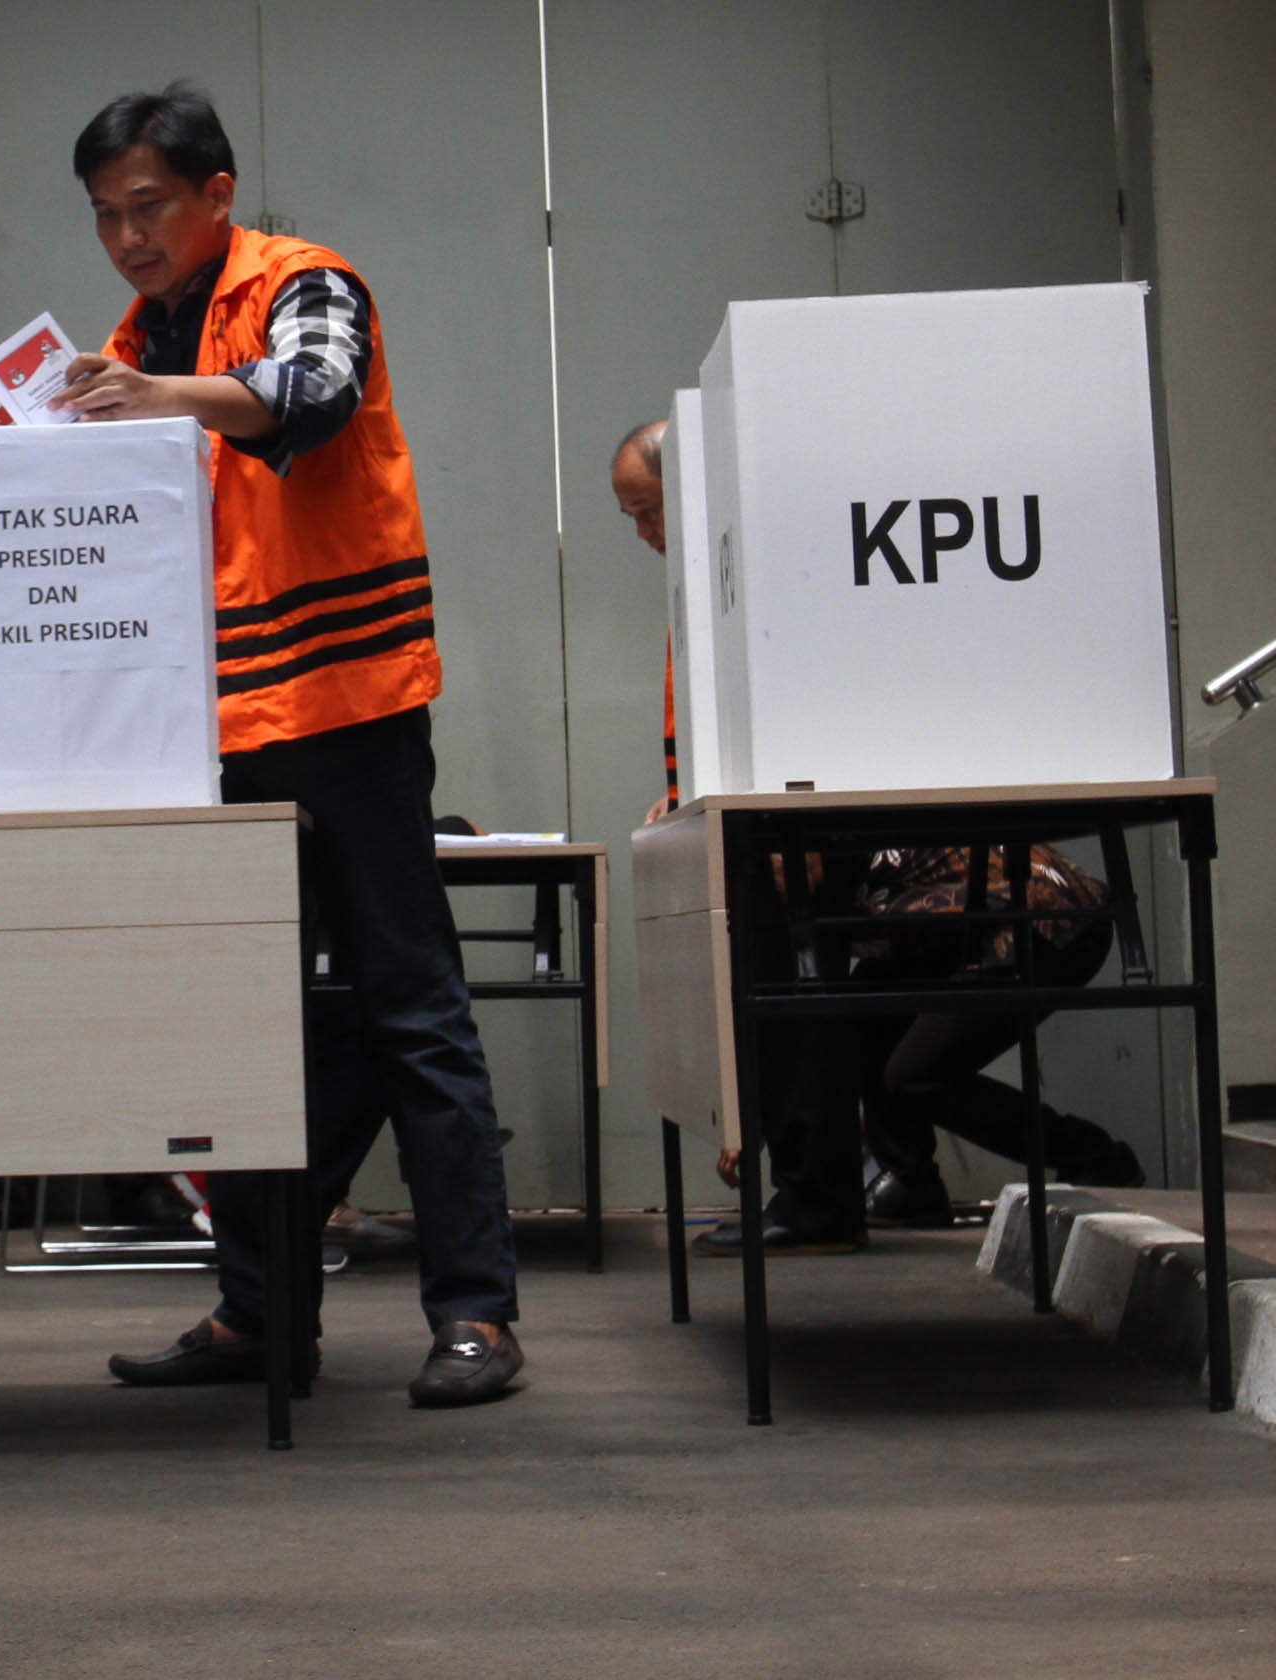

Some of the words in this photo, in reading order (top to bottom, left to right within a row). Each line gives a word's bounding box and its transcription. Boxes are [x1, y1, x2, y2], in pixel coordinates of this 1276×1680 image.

[53, 504, 139, 528] SUARA
[850, 494, 1042, 587] KPU
[28, 585, 77, 605] DAN
[40, 620, 148, 643] PRESIDEN
